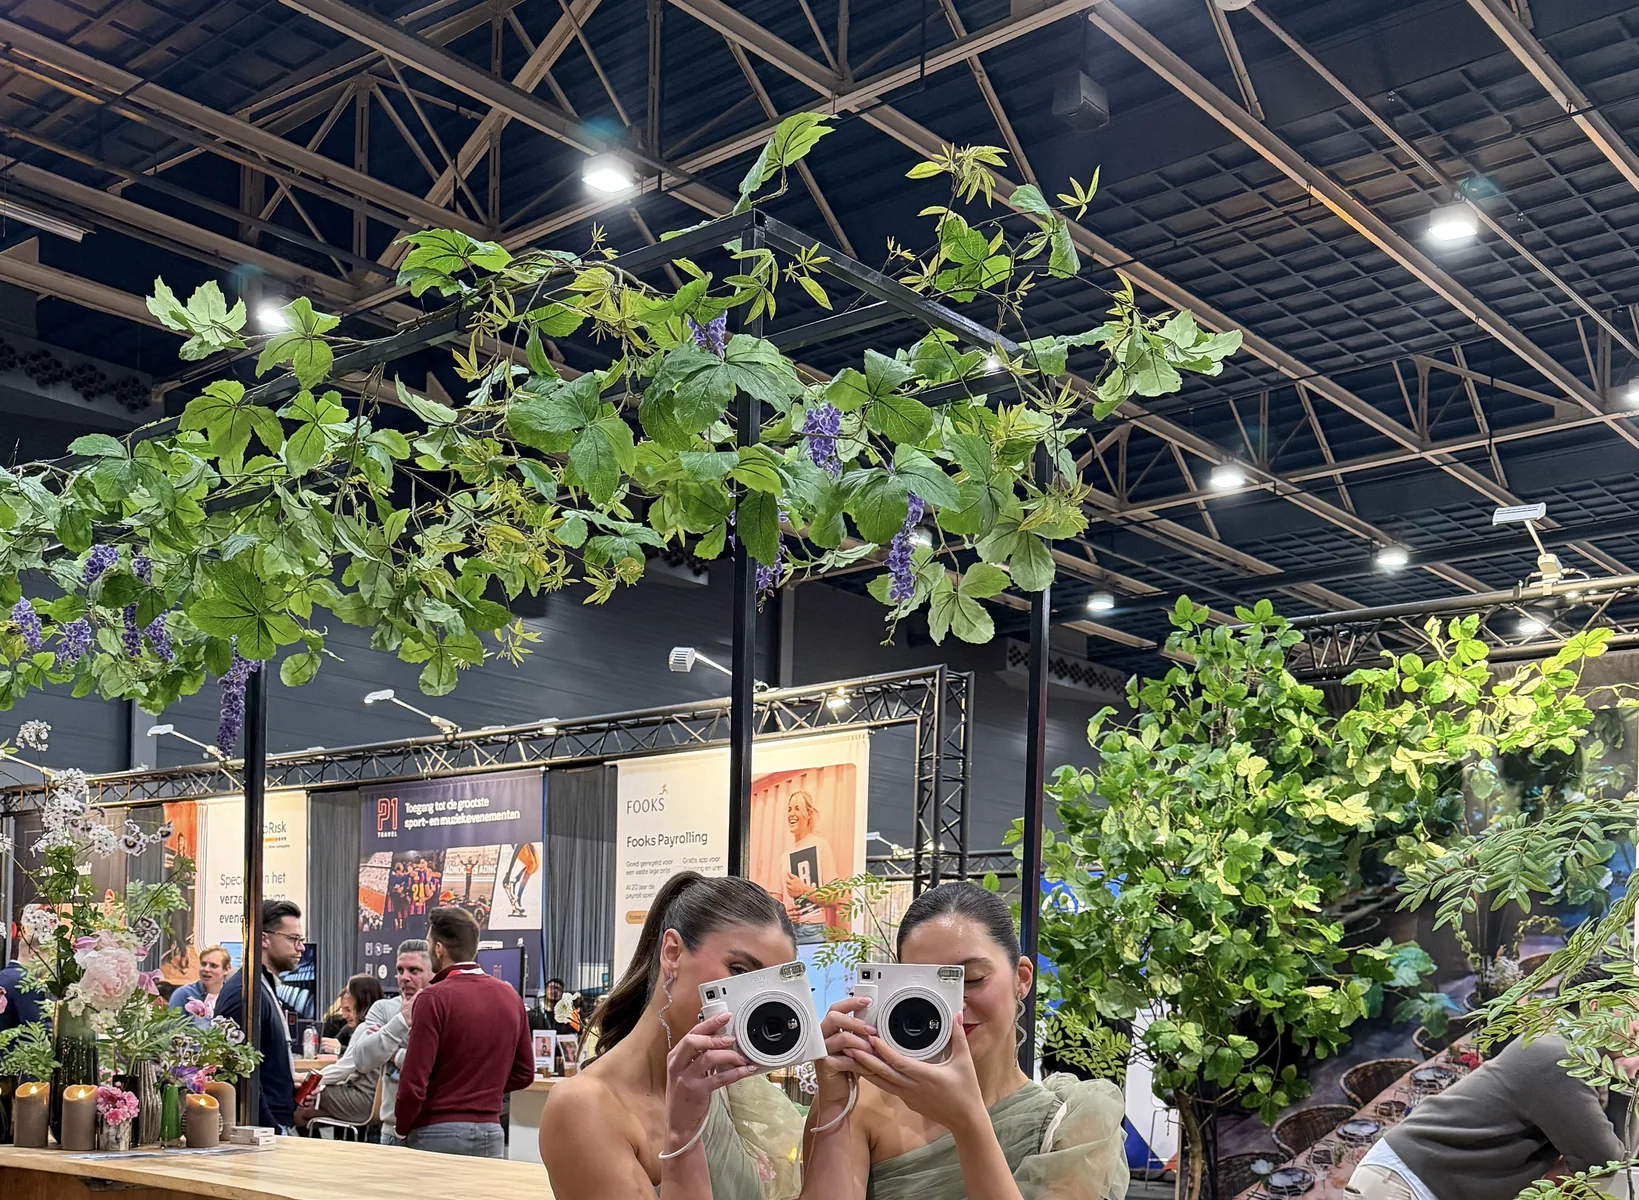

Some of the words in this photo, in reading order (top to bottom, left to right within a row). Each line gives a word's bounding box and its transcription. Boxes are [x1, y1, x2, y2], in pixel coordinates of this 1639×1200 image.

[377, 797, 399, 831] P1
[404, 802, 435, 815] Toegang
[435, 800, 446, 812] tot
[446, 799, 458, 811] de
[457, 797, 490, 811] grootste
[626, 797, 665, 814] FOOKS
[404, 816, 429, 830] sport-
[429, 816, 440, 827] en
[440, 809, 521, 826] muziekevenementen
[626, 834, 656, 848] Fooks
[657, 831, 708, 848] Payrolling
[220, 873, 243, 889] Speci
[271, 871, 287, 884] het
[219, 913, 245, 924] evene
